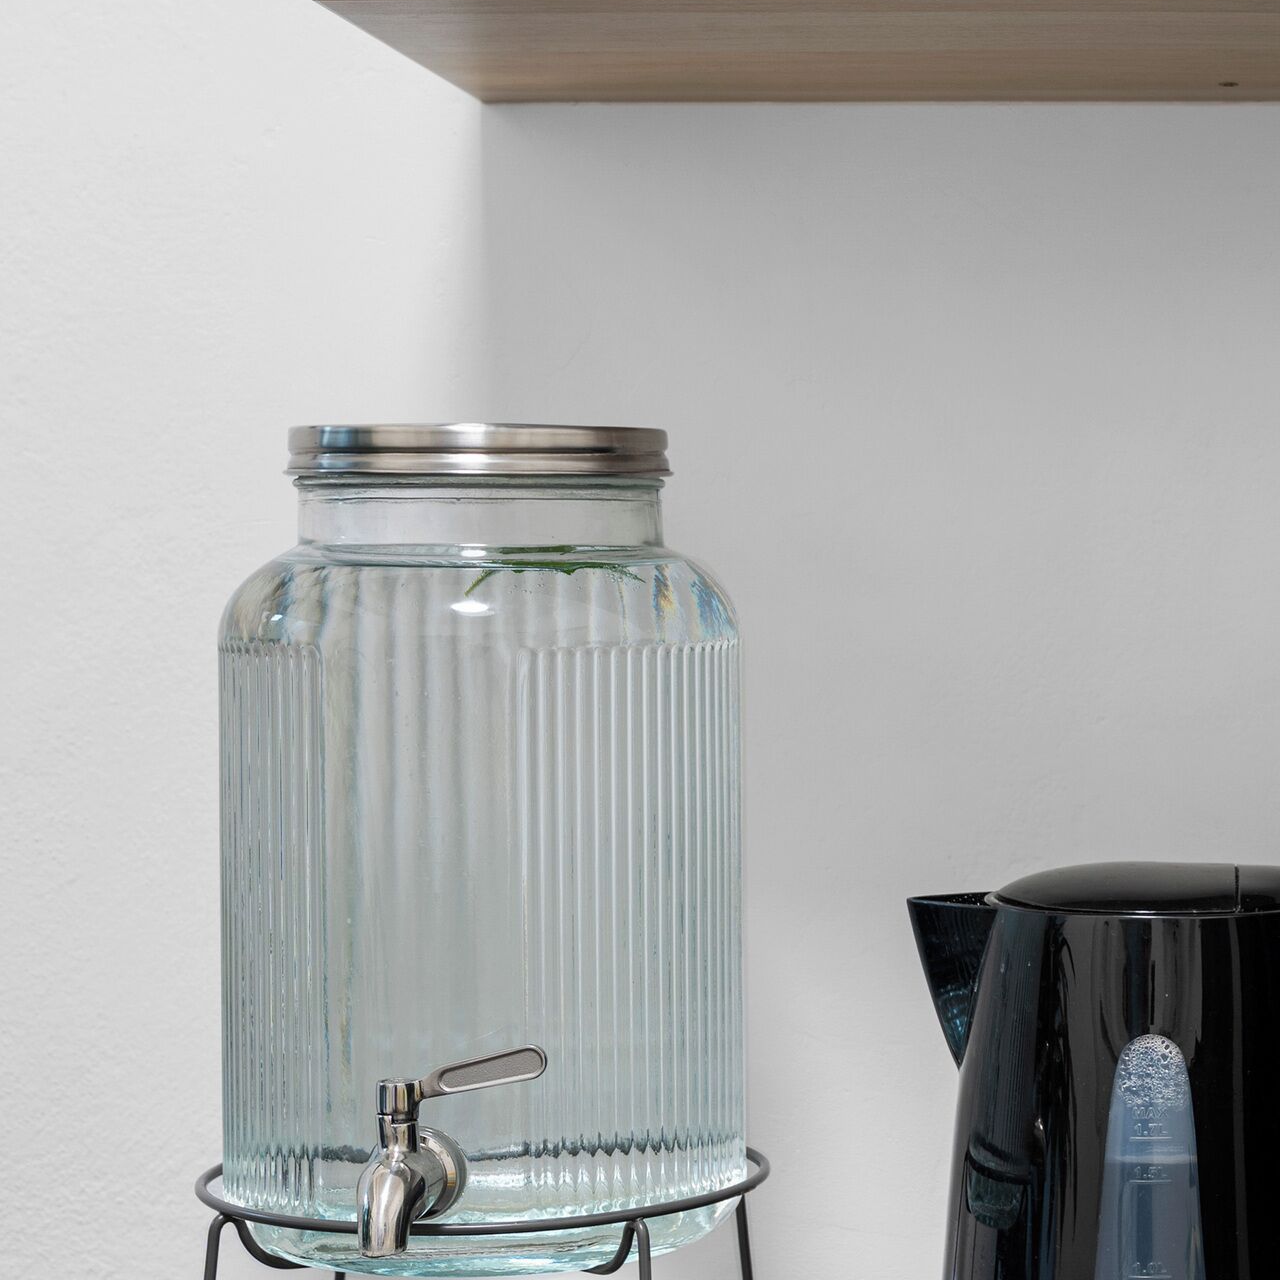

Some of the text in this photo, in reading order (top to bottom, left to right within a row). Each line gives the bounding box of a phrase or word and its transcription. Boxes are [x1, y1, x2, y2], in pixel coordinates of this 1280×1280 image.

[1132, 1106, 1169, 1120] MAX
[1133, 1123, 1169, 1136] 1.7L
[1133, 1166, 1168, 1179] 1.5L
